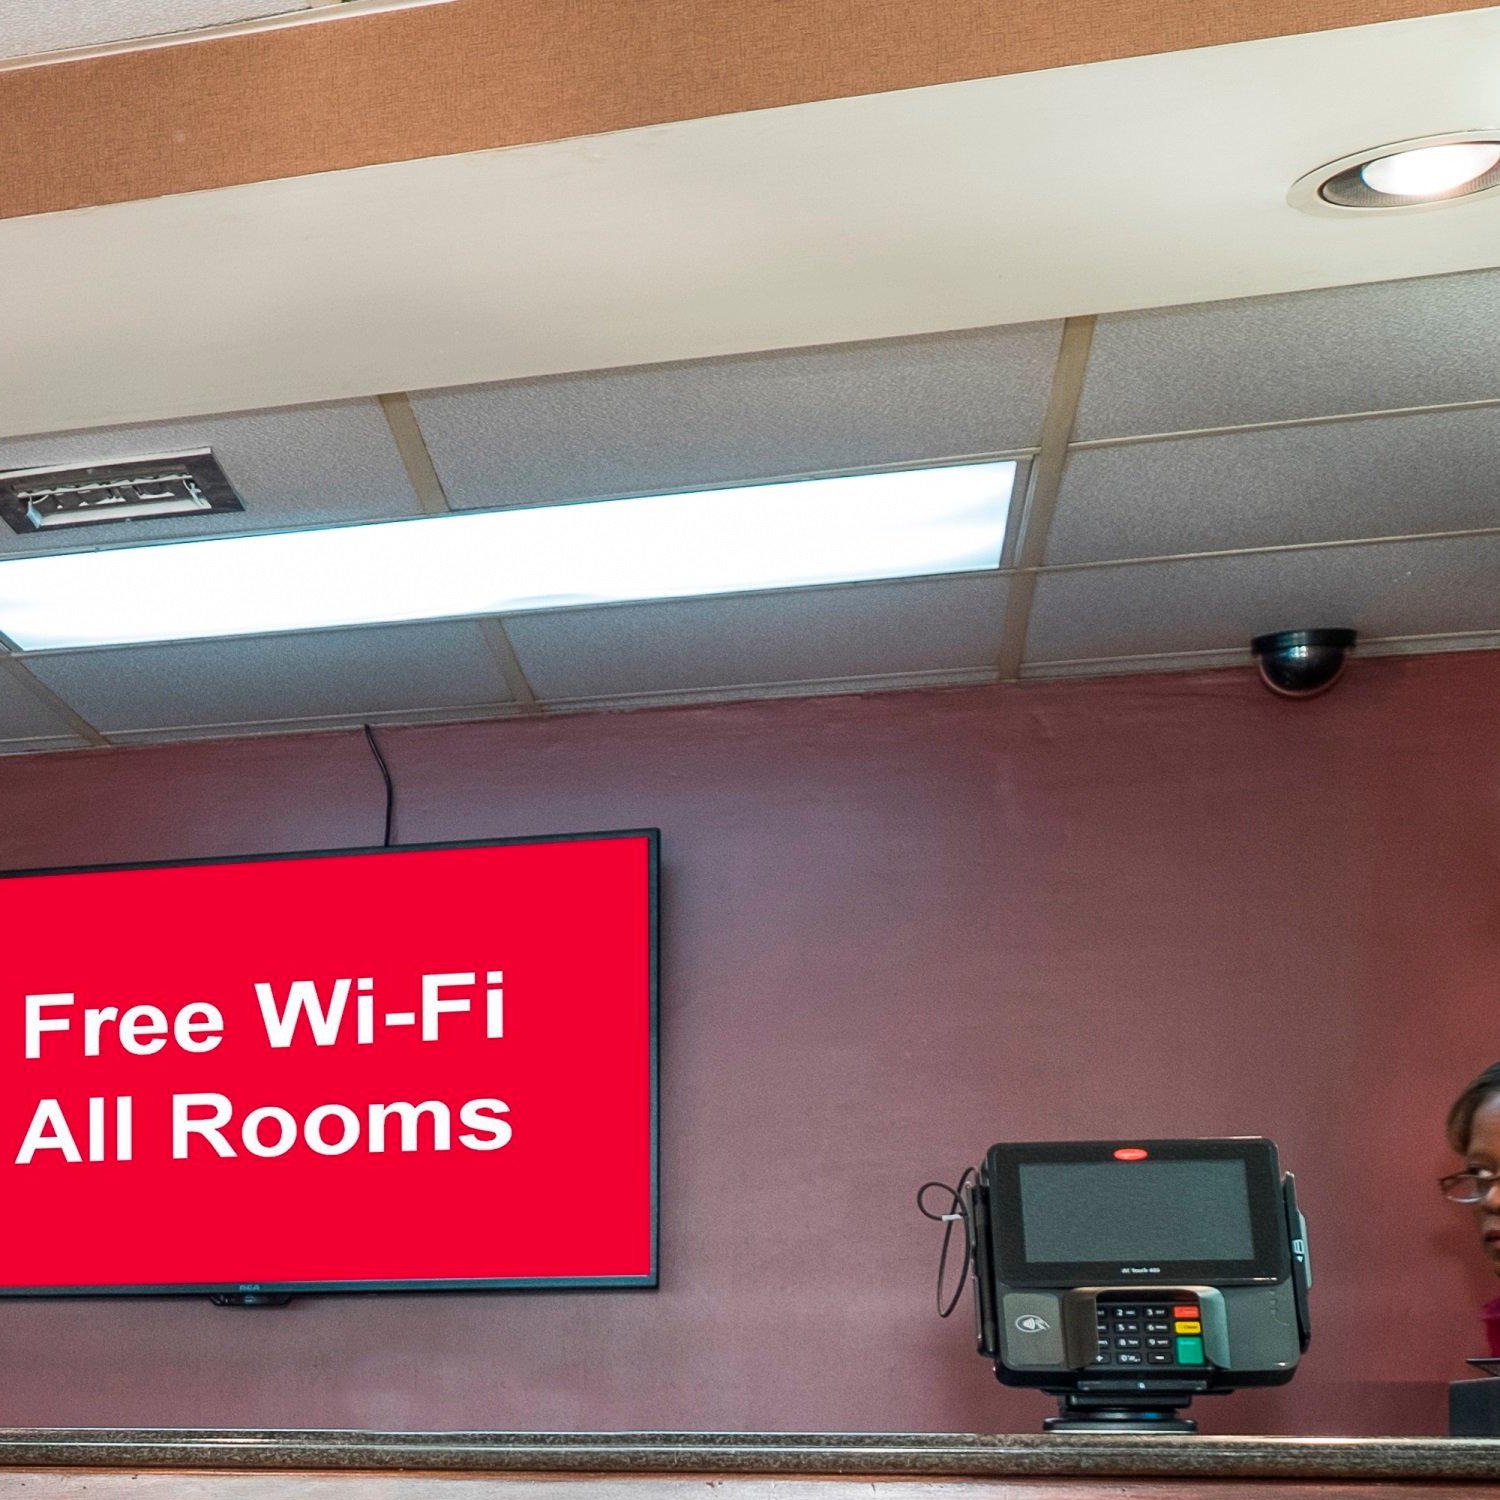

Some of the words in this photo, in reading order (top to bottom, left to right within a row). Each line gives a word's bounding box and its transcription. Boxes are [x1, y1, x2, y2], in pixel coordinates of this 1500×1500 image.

[26, 993, 224, 1059] Free
[255, 971, 504, 1048] Wi-Fi
[15, 1096, 133, 1165] All
[173, 1093, 513, 1160] Rooms
